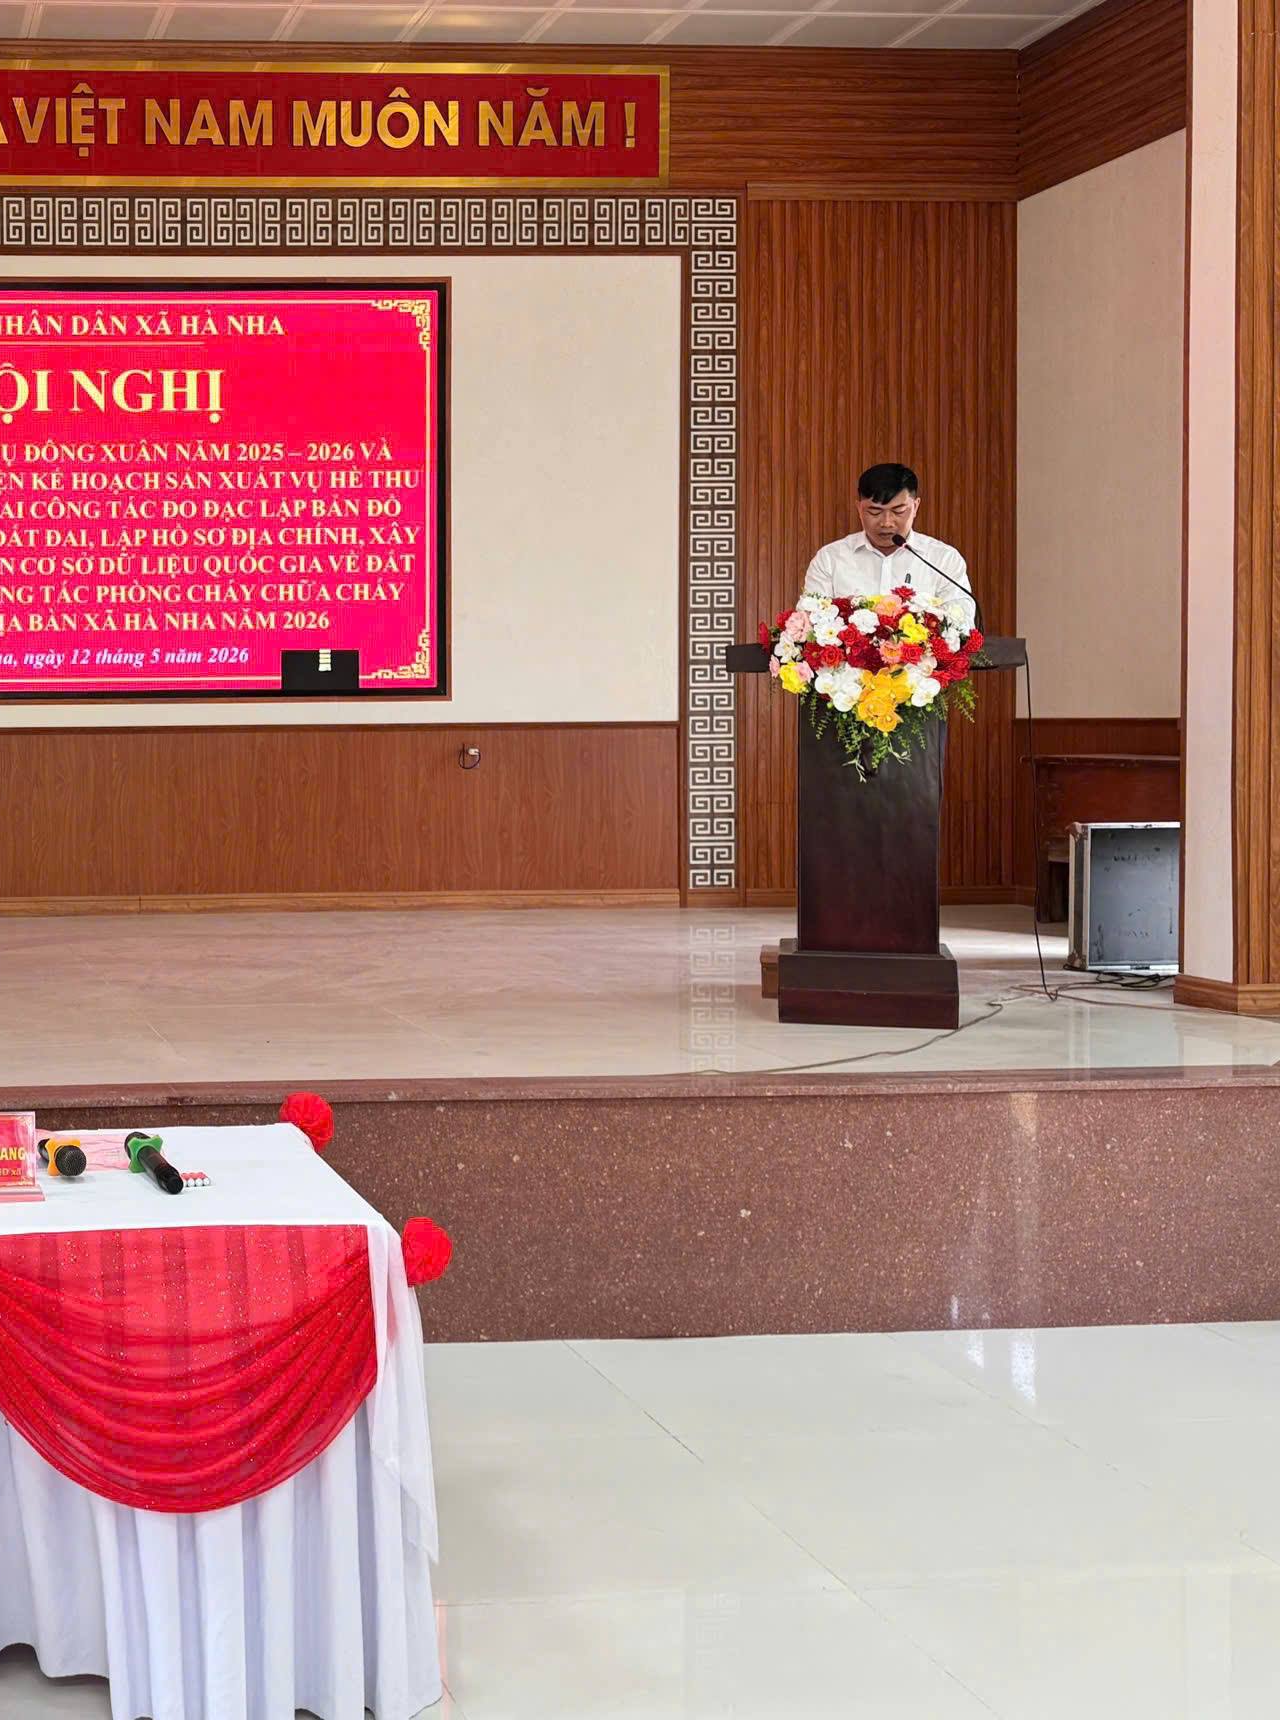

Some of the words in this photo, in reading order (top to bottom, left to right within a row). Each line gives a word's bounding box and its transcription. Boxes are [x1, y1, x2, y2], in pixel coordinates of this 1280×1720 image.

[13, 82, 126, 157] VIỆT
[144, 98, 274, 146] NAM
[292, 86, 460, 149] MUÔN
[477, 87, 605, 147] NĂM
[72, 309, 127, 336] DÂN
[136, 309, 173, 336] XÃ
[181, 309, 218, 336] HÀ
[228, 315, 285, 336] NHA
[70, 368, 225, 424] NGHỊ
[23, 439, 96, 461] ĐÔNG
[100, 439, 168, 461] XUÂN
[175, 439, 231, 460] NĂM
[236, 444, 285, 460] 2025
[307, 444, 355, 460] 2026
[359, 439, 393, 460] VÀ
[31, 466, 66, 489] KẾ
[71, 471, 161, 494] HOẠCH
[218, 465, 286, 488] XUẤT
[289, 471, 322, 493] VỤ
[329, 466, 364, 488] HÈ
[29, 496, 102, 518] CÔNG
[106, 496, 158, 517] TÁC
[161, 501, 198, 517] ĐO
[203, 500, 253, 522] ĐẠC
[260, 495, 308, 522] LẬP
[311, 495, 360, 517] BẢN
[45, 529, 95, 549] ĐAI,
[99, 524, 149, 551] LẬP
[152, 522, 190, 545] HỒ
[193, 526, 227, 545] SƠ
[230, 528, 275, 550] ĐỊA
[277, 523, 366, 548] CHÍNH,
[368, 523, 420, 545] XÂY
[19, 555, 58, 574] CƠ
[61, 552, 96, 574] SỞ
[98, 551, 136, 574] DỮ
[140, 551, 199, 579] LIỆU
[202, 550, 276, 576] QUỐC
[279, 556, 325, 573] GIA
[327, 549, 361, 573] VỀ
[366, 549, 416, 573] ĐẤT
[39, 581, 90, 602] TÁC
[95, 580, 182, 602] PHÒNG
[186, 580, 257, 602] CHÁY
[260, 580, 332, 601] CHỮA
[335, 579, 405, 601] CHÁY
[28, 609, 78, 631] BÀN
[83, 608, 118, 630] XÃ
[123, 608, 159, 630] HÀ
[164, 613, 217, 630] NHA
[221, 607, 277, 629] NĂM
[282, 612, 330, 629] 2026
[23, 650, 65, 671] ngày
[71, 649, 91, 665] 12
[96, 648, 145, 667] tháng
[150, 648, 160, 665] 5
[165, 650, 202, 664] năm
[208, 647, 249, 664] 2026
